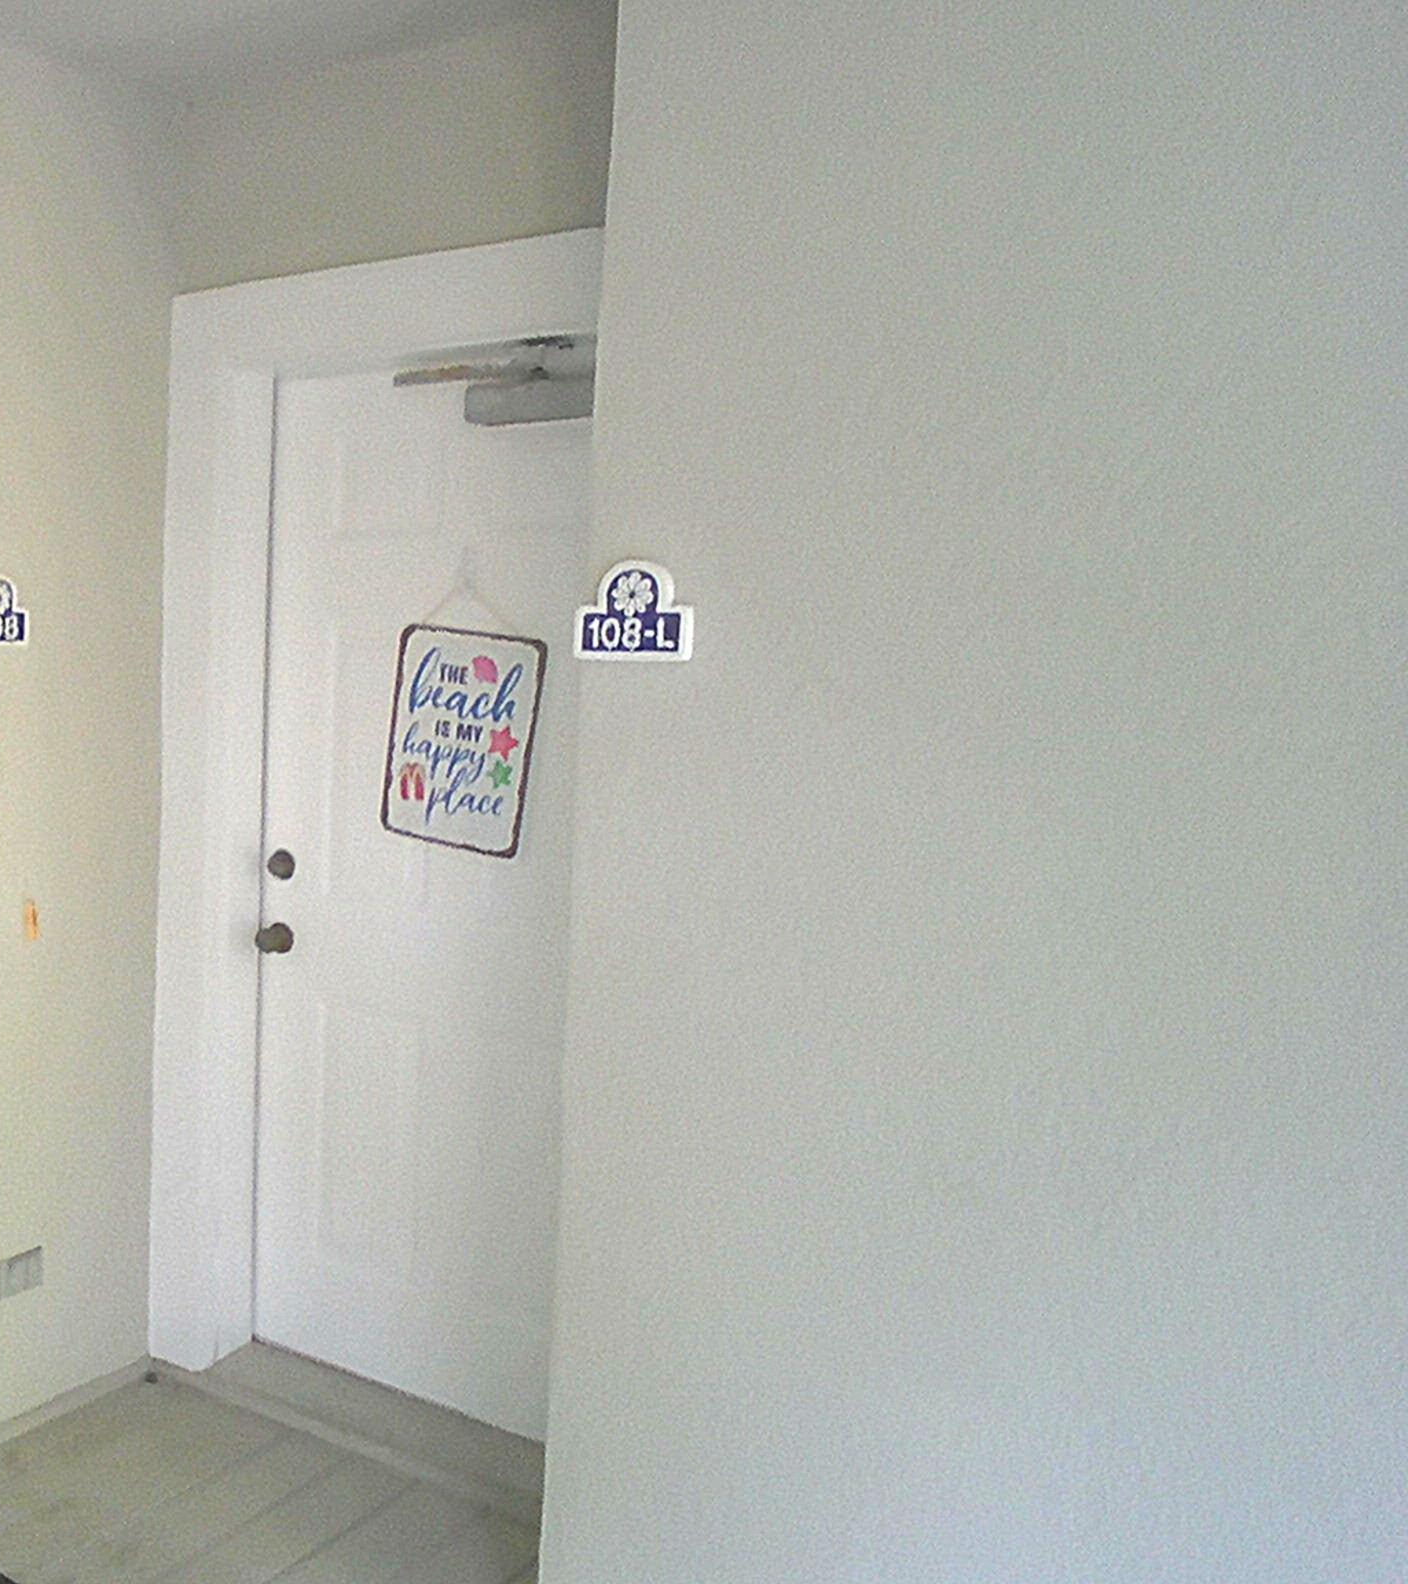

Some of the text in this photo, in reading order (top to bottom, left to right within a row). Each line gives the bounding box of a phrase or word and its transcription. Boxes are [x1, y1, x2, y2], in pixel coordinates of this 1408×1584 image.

[587, 617, 675, 651] 108-L
[409, 647, 523, 723] beach
[439, 663, 469, 685] THE
[402, 721, 486, 784] happy
[435, 719, 483, 743] IS MY
[425, 767, 504, 826] place
